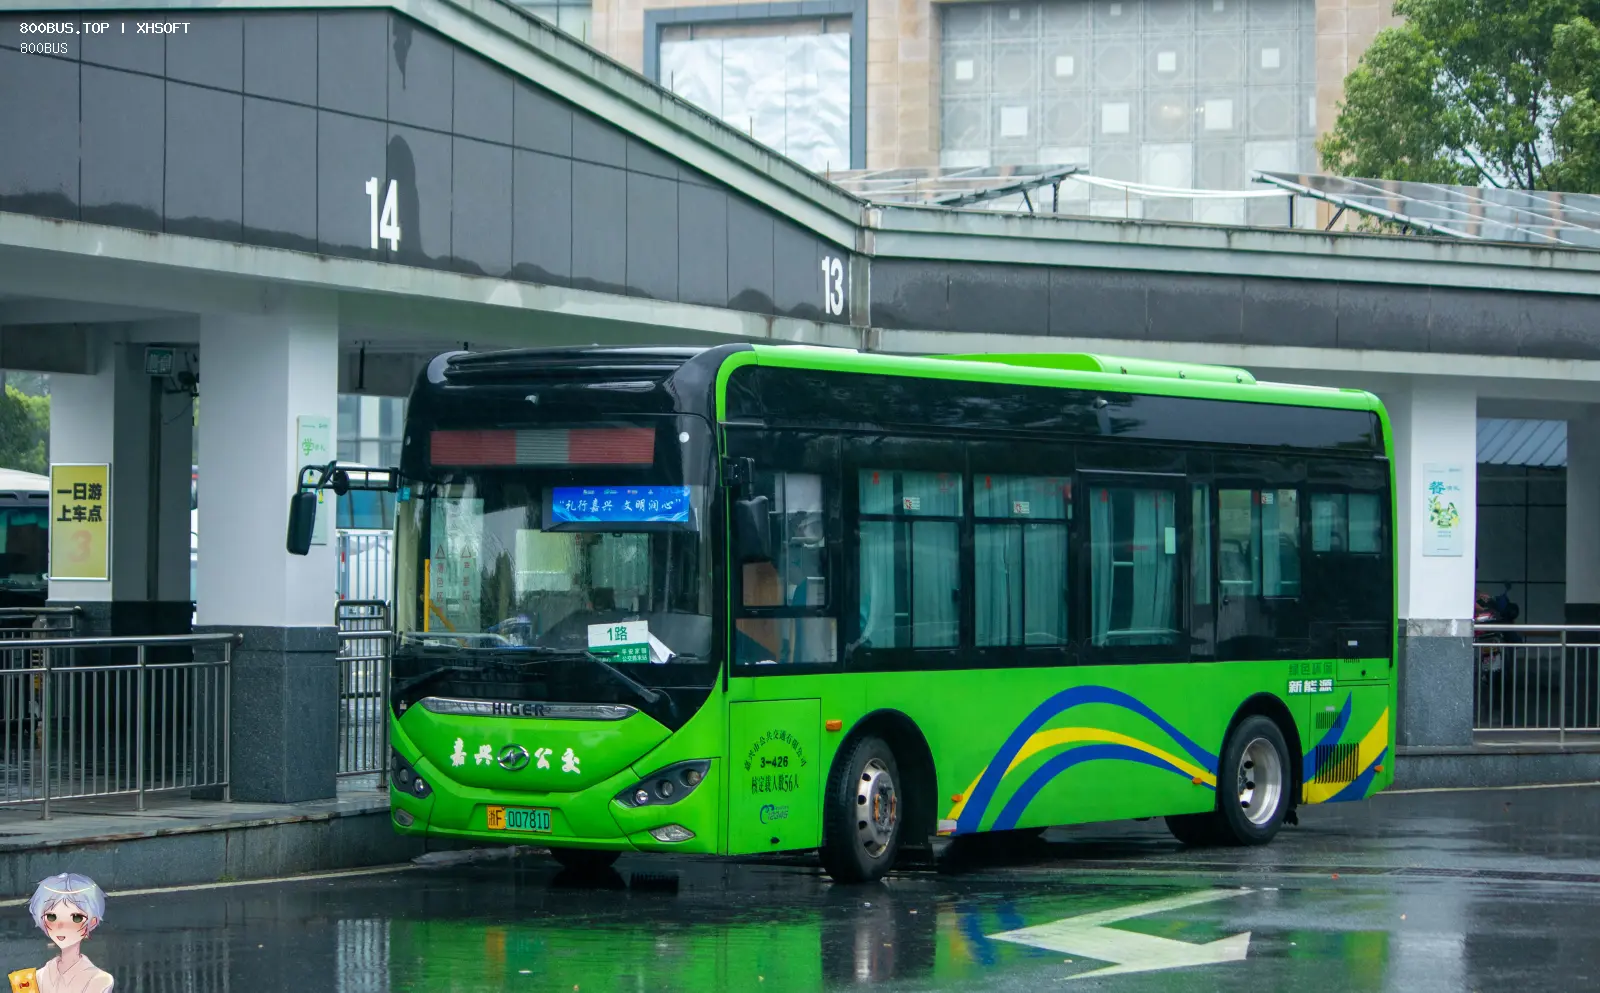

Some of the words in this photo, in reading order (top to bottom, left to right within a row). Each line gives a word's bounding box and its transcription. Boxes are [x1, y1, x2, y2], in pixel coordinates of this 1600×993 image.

[365, 176, 401, 252] 14
[821, 255, 844, 316] 13
[57, 482, 102, 500] 一日游
[57, 504, 102, 522] 上车点
[67, 529, 93, 562] 3
[606, 625, 628, 641] 1路
[1288, 679, 1332, 693] 新能源
[492, 702, 545, 717] HIGER
[450, 737, 493, 767] 嘉兴
[534, 747, 581, 774] 公交
[760, 756, 789, 768] 3-426
[508, 810, 550, 830] 00781D
